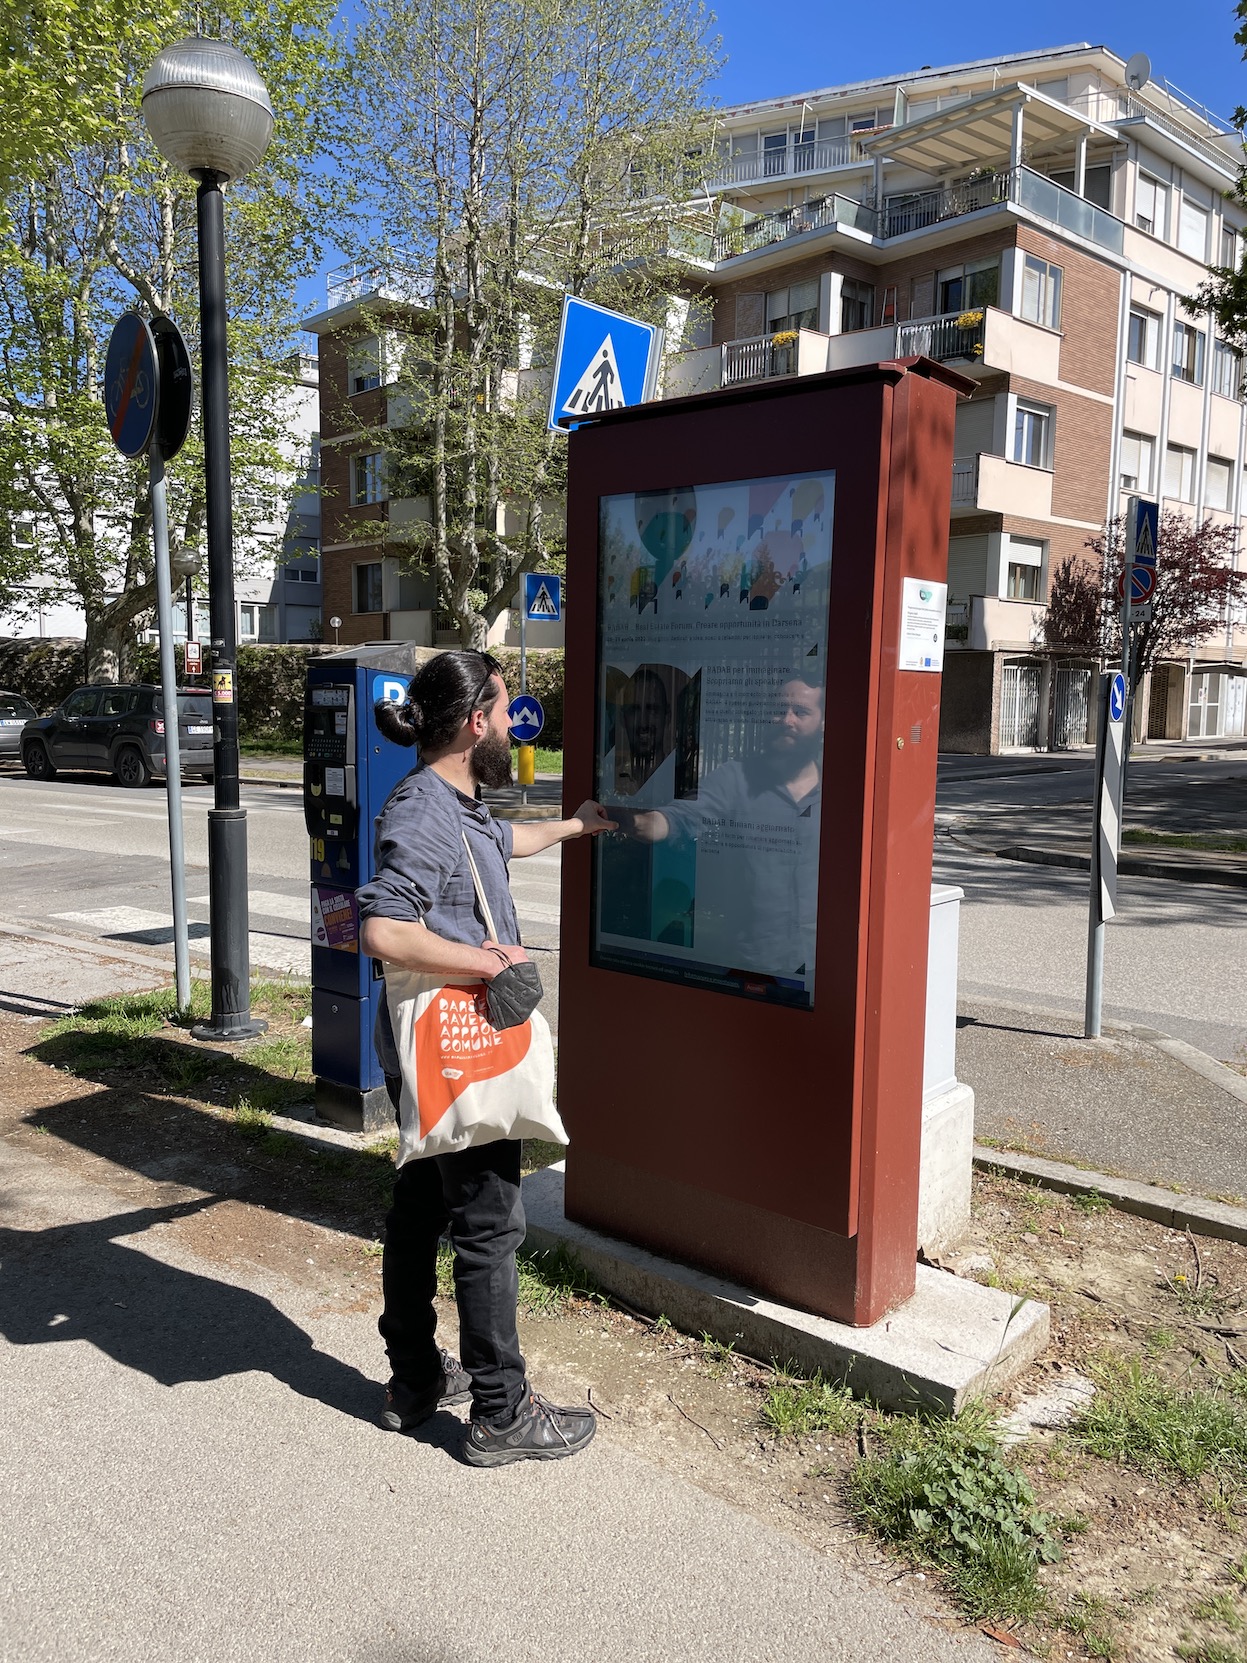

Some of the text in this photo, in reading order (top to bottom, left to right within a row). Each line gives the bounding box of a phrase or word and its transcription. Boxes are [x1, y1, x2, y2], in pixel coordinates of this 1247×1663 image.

[771, 617, 802, 627] Darsena
[732, 666, 744, 675] per
[706, 677, 784, 687] Scopriamo gli speaker
[383, 681, 406, 706] P
[440, 1032, 504, 1053] COMUNE
